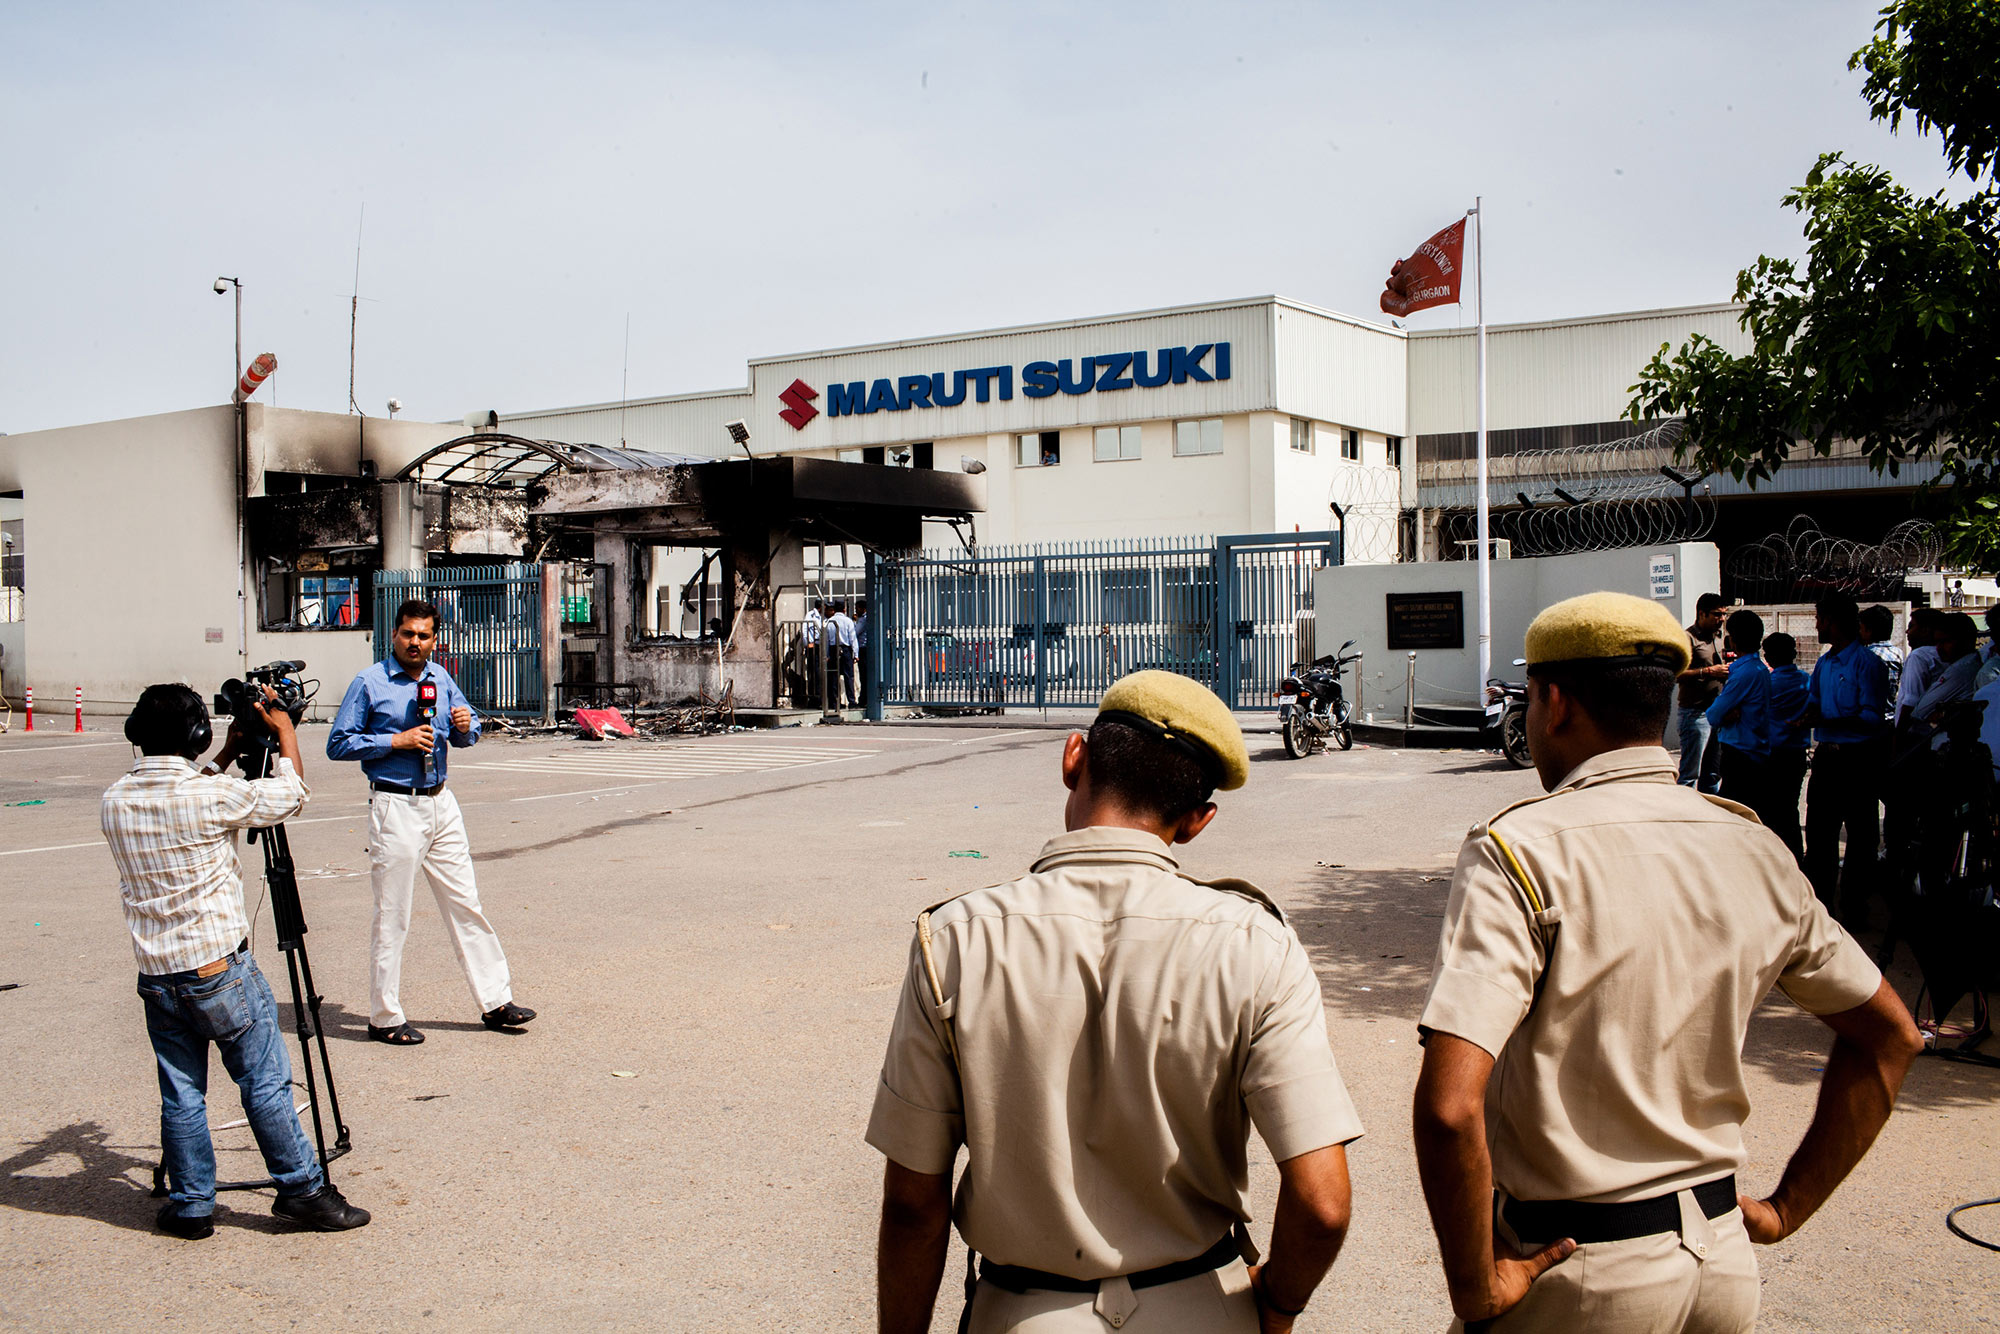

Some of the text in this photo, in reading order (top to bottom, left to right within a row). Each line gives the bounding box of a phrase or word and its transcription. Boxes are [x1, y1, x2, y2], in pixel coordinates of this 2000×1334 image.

[1413, 285, 1451, 302] GURGAON
[827, 342, 1231, 417] MARUTI SUZUKI
[423, 687, 435, 698] 18
